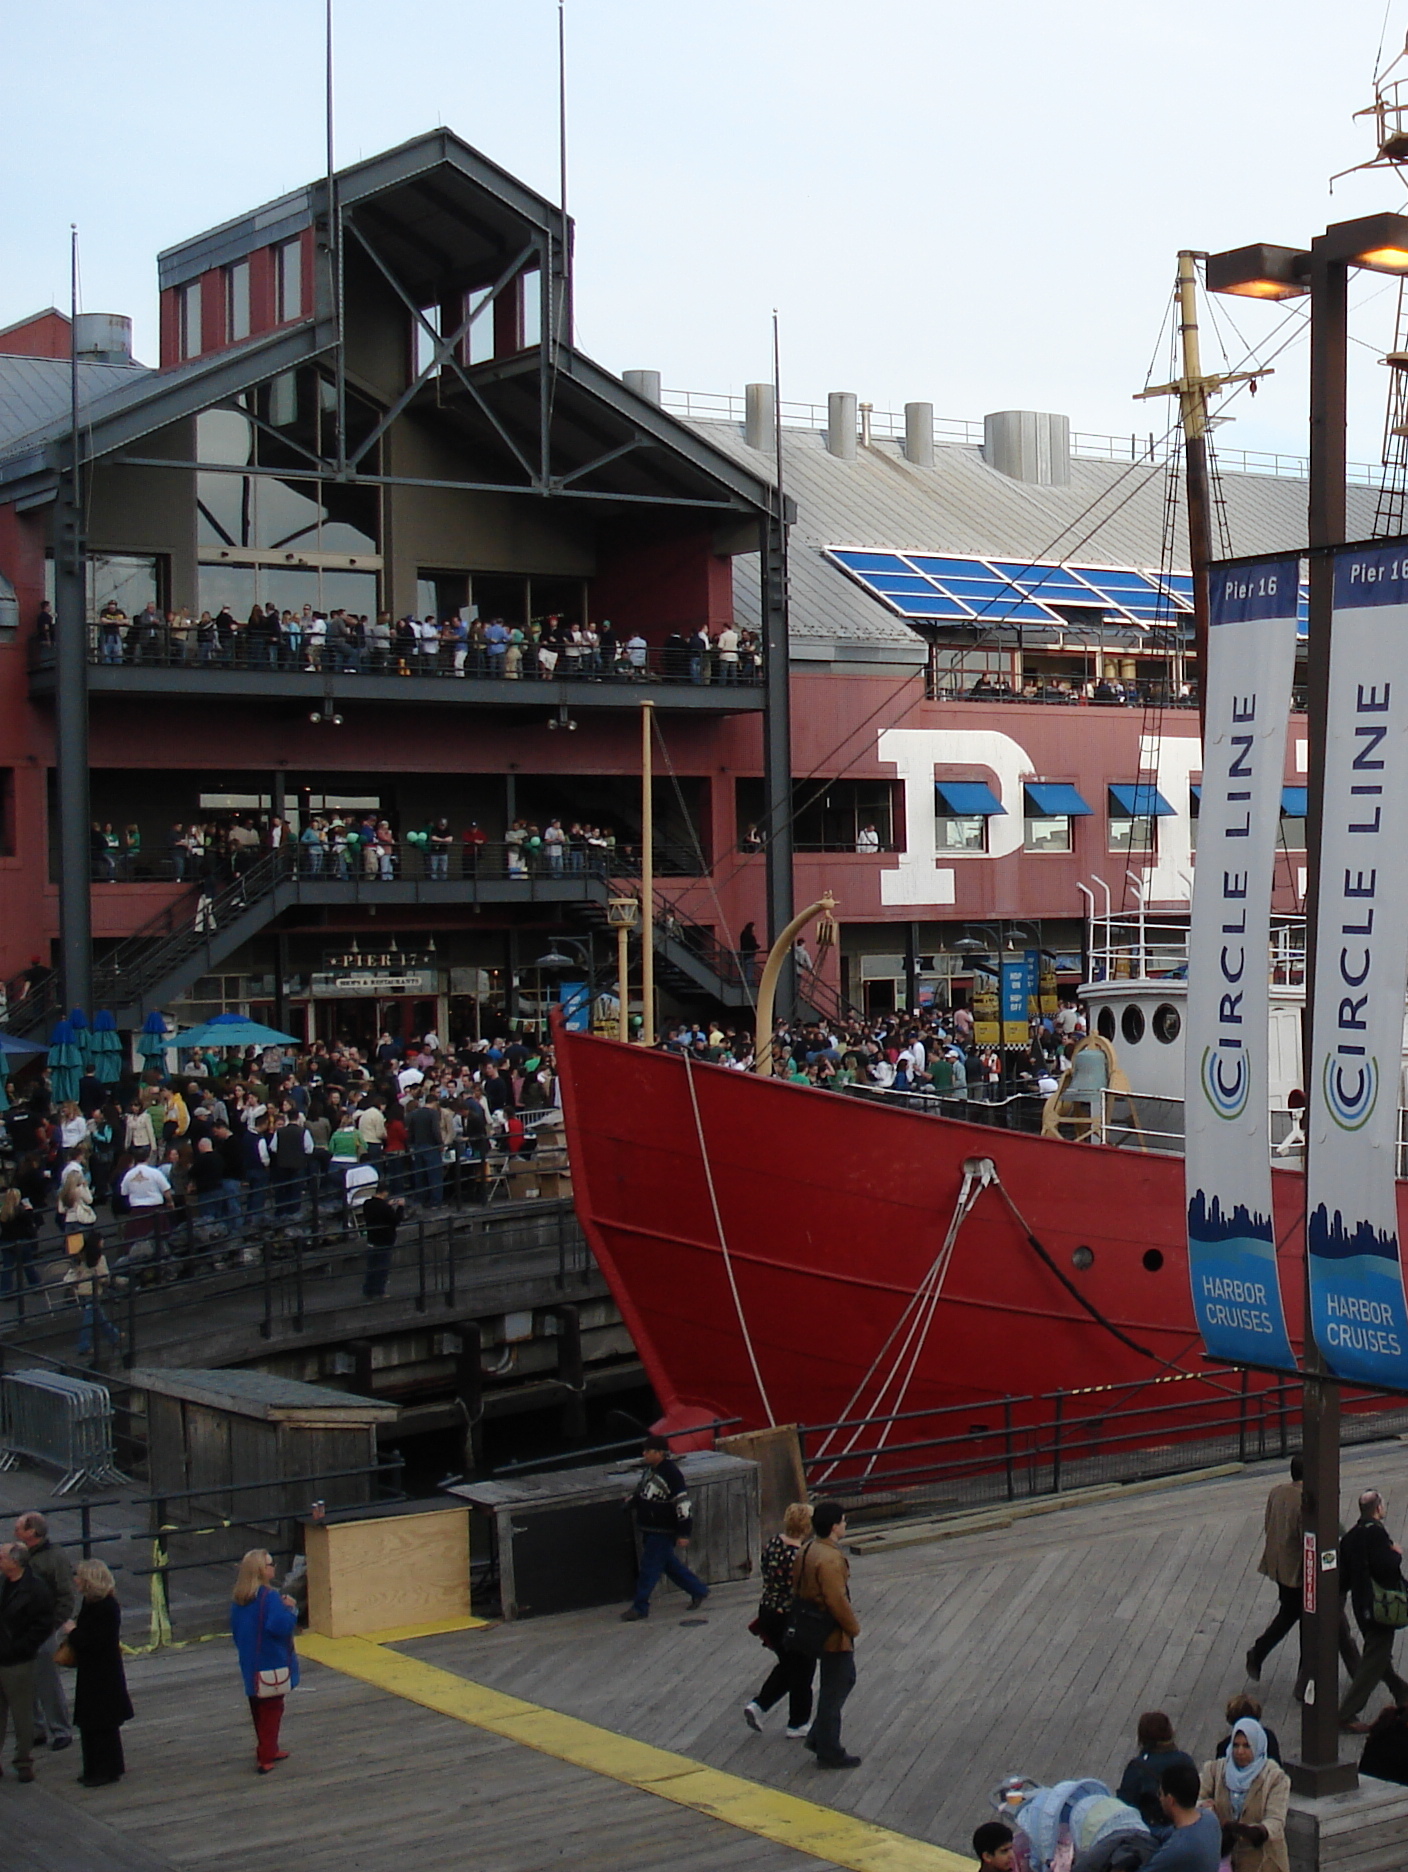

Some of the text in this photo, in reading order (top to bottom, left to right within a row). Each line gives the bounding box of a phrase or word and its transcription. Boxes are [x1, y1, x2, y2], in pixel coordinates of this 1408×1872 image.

[1225, 576, 1278, 600] Pier 16
[1350, 564, 1385, 584] Pier
[1217, 693, 1256, 1098] CIRCLE LINE
[1336, 682, 1391, 1108] CIRCLE LINE
[343, 953, 417, 967] PIER 17
[1203, 1275, 1267, 1305] HARBOR
[1206, 1303, 1273, 1334] CRUISES
[1327, 1293, 1395, 1327] HARBOR
[1327, 1323, 1401, 1355] CRUISES
